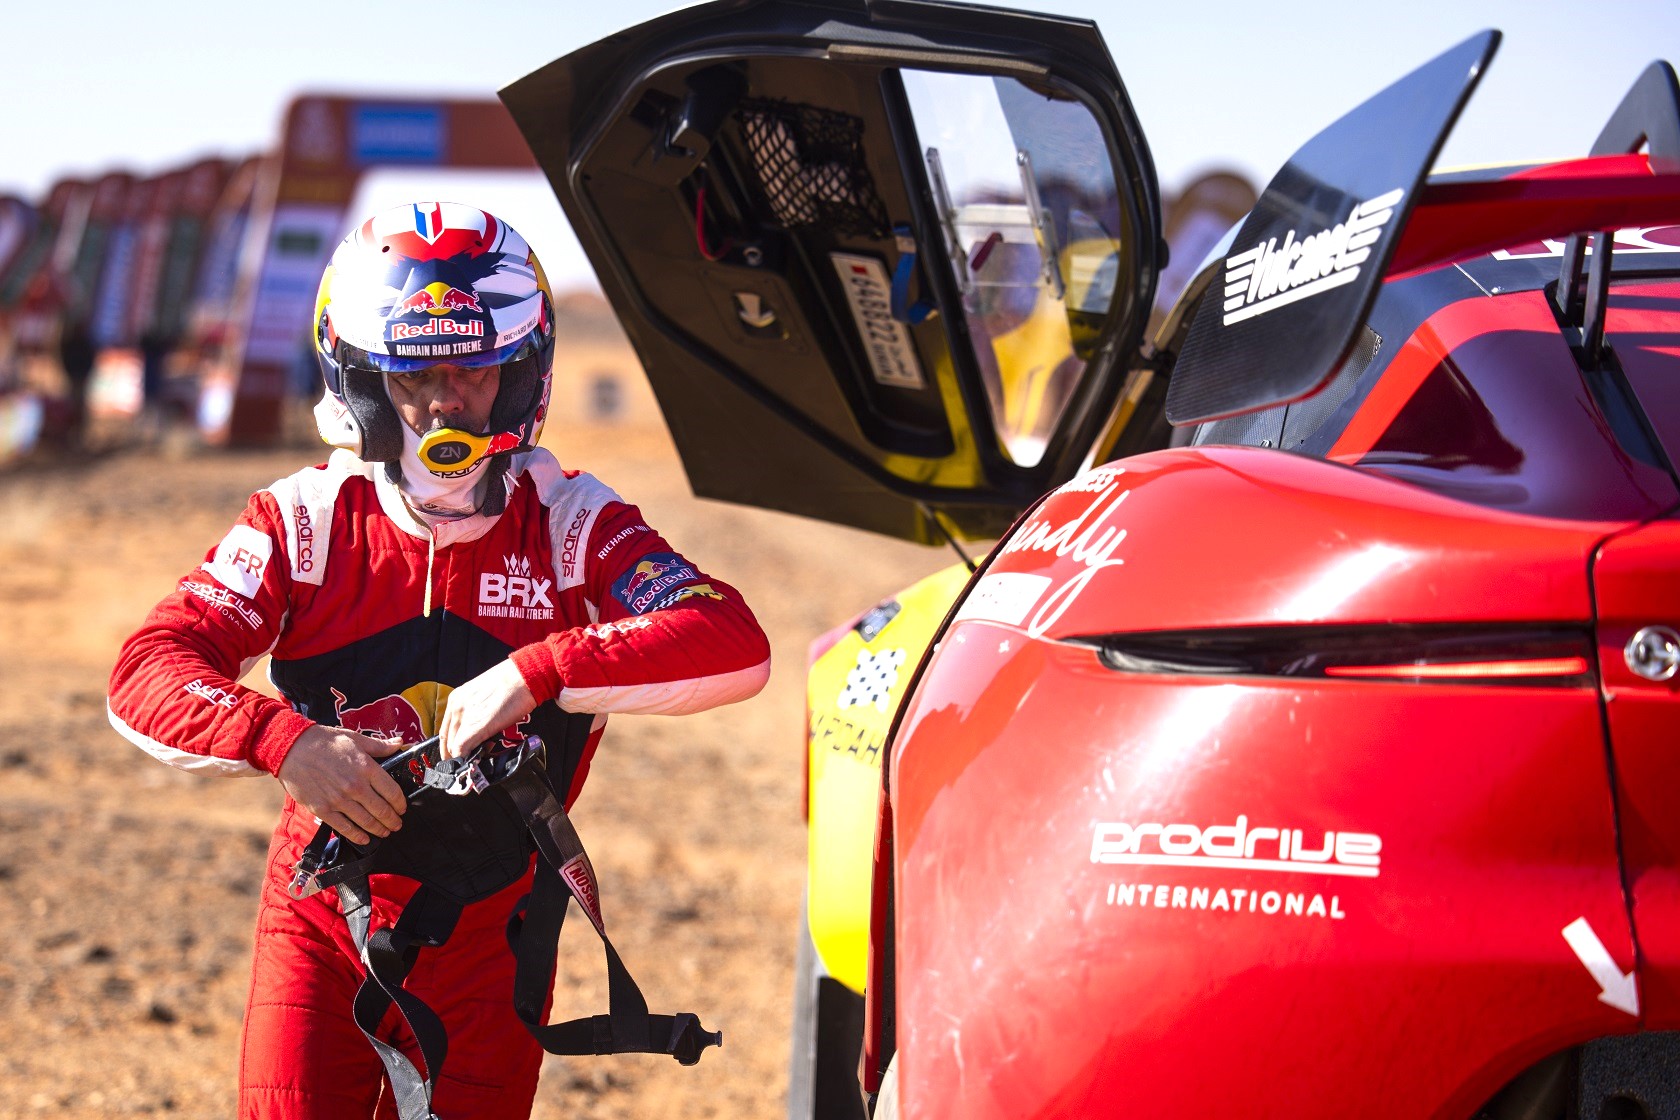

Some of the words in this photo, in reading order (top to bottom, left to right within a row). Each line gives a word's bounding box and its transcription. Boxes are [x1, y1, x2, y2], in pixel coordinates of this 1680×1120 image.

[392, 318, 437, 341] Red
[439, 319, 484, 336] Bull
[503, 325, 527, 342] RICHARD
[396, 344, 430, 356] BAHRAIN
[432, 344, 451, 356] RAID
[453, 340, 482, 355] XTREME
[293, 503, 314, 573] sparco
[562, 508, 592, 579] sparco
[597, 527, 635, 560] RICHARD
[479, 572, 554, 608] BRX
[632, 579, 667, 614] Red
[659, 567, 698, 587] Bull
[478, 605, 508, 617] BAHRAIN
[526, 608, 554, 620] XTREME
[1090, 814, 1382, 877] prodrive
[1107, 883, 1345, 920] INTERNATIONAL
